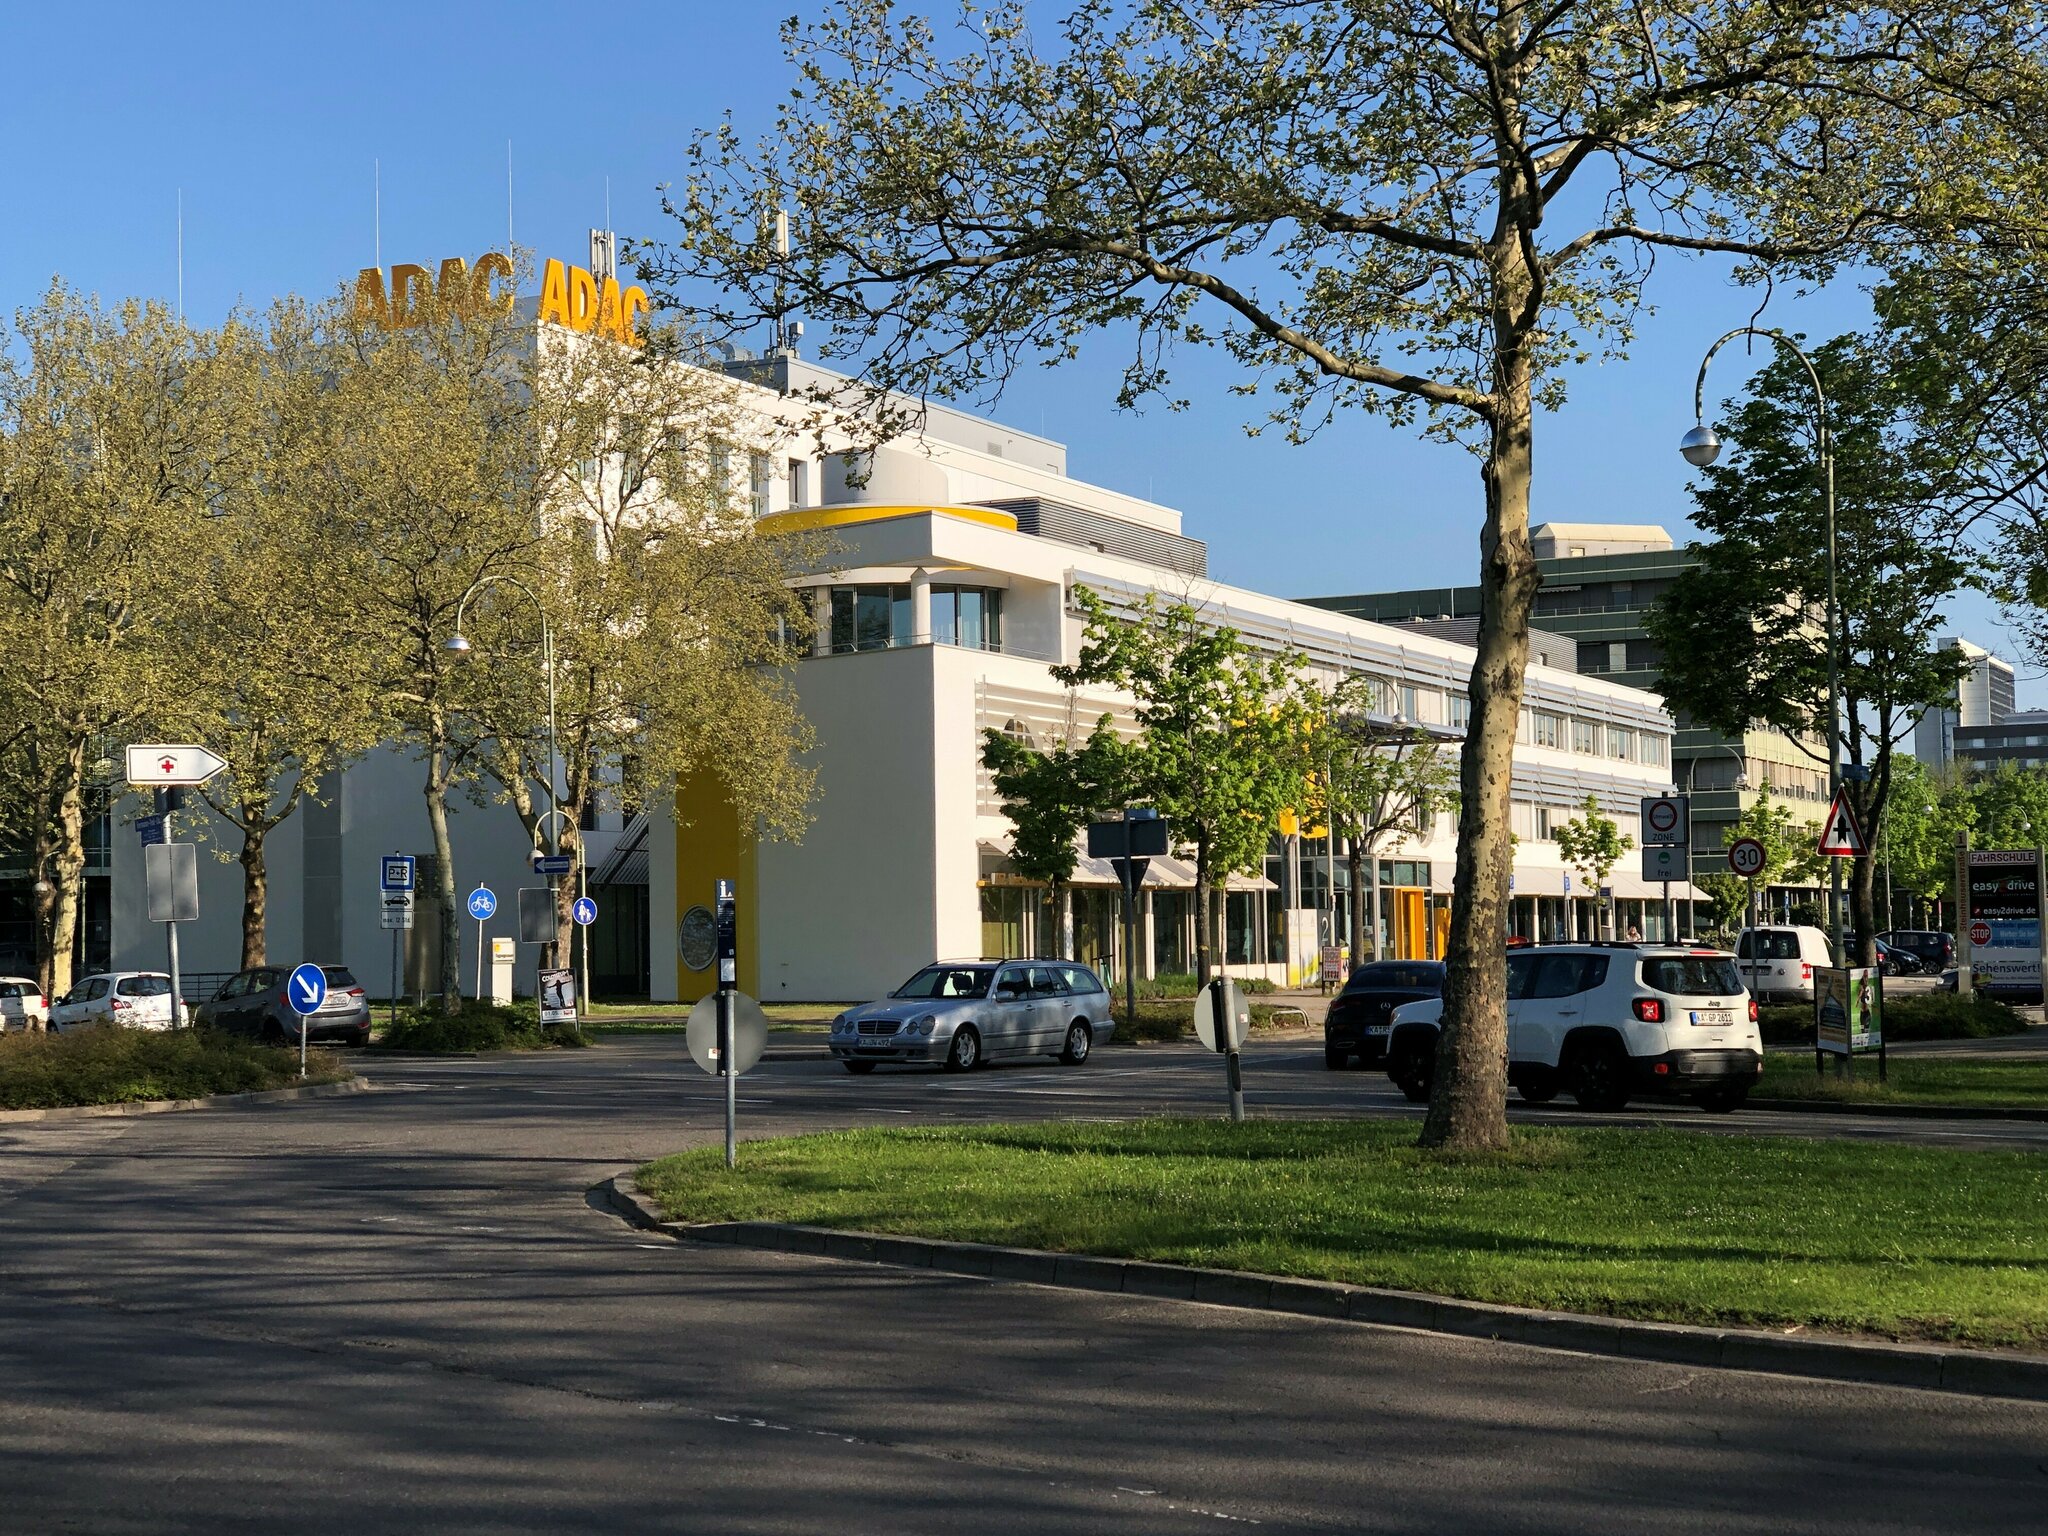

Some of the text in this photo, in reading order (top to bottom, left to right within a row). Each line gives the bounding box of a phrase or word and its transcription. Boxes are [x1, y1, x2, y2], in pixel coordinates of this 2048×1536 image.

[354, 252, 514, 329] ADAC
[541, 257, 650, 349] ADAC
[1652, 832, 1675, 842] ZONE
[1736, 848, 1759, 867] 30
[1971, 852, 2035, 863] FAHRSCHULE
[1657, 868, 1672, 877] frei
[1983, 907, 2036, 916] easy2drive.de
[1321, 916, 1329, 942] 2
[1971, 928, 1990, 939] STOP
[1972, 963, 2041, 974] Sehenswert!
